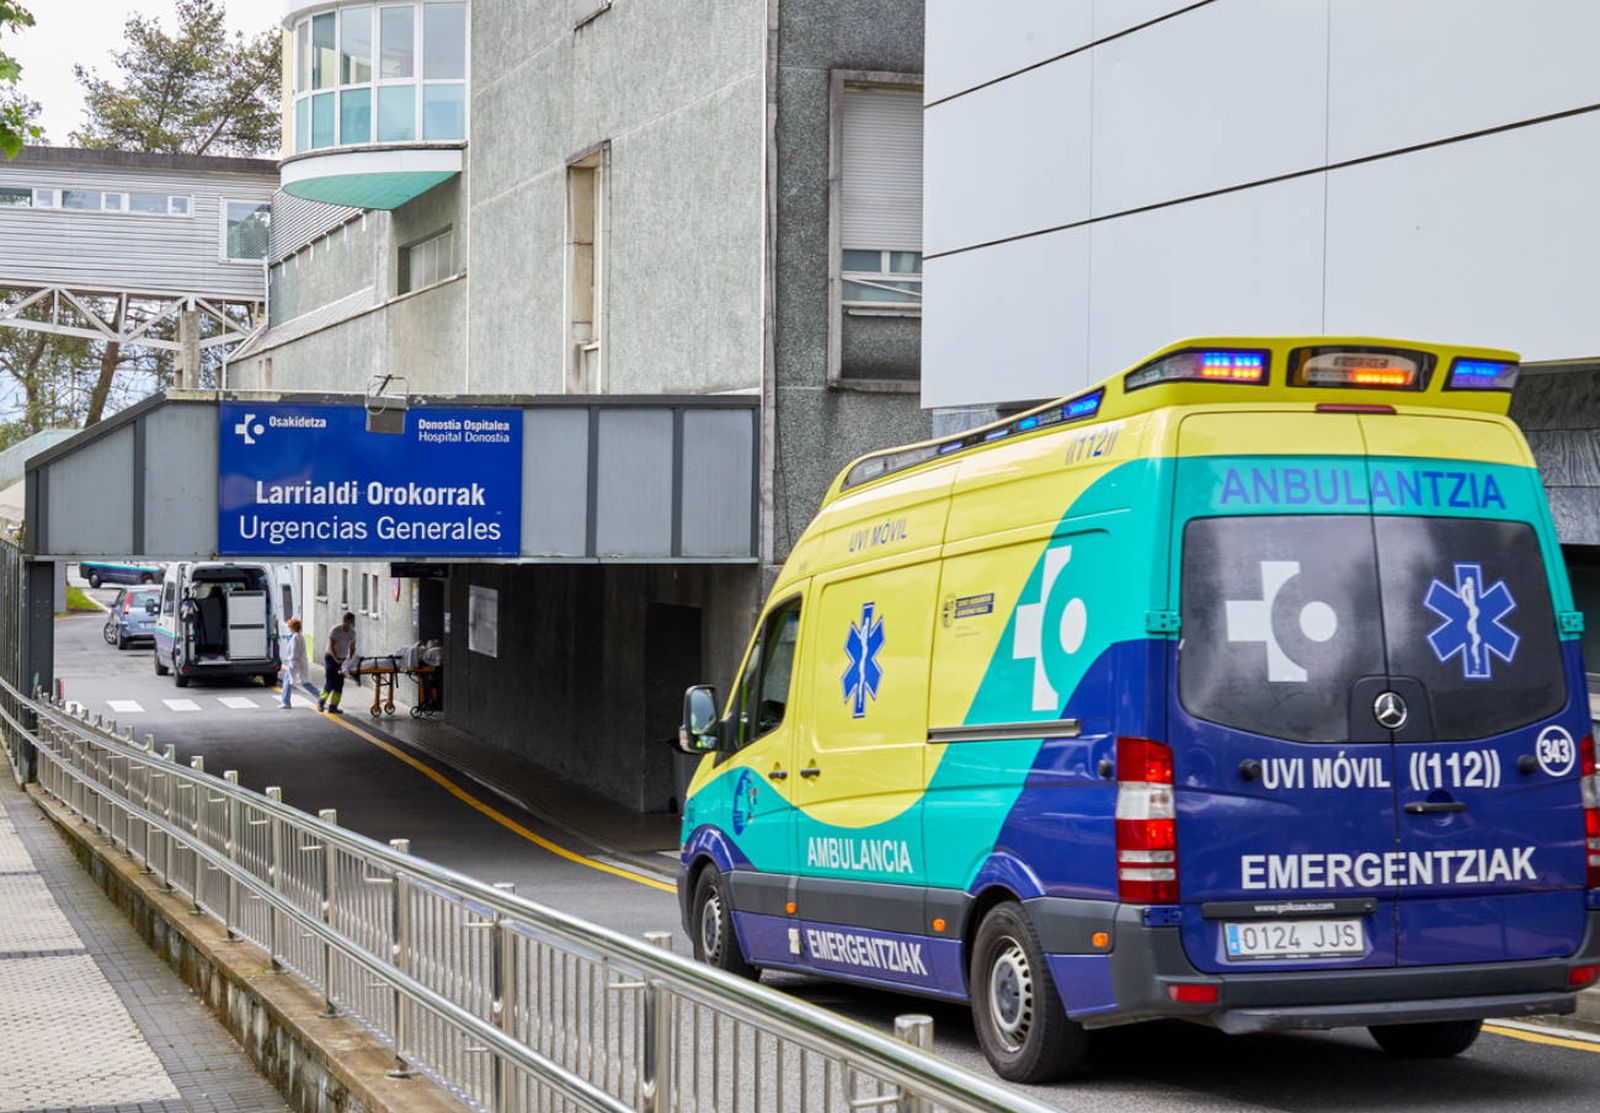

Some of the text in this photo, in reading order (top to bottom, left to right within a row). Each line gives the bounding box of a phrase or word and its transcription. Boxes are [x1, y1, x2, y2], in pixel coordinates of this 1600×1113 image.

[269, 416, 327, 429] Osakidetza
[419, 419, 510, 433] Donostia Ospitalea
[419, 432, 510, 444] Hospital Donostia
[256, 480, 486, 506] Larrialdi Orokorrak
[1220, 467, 1507, 510] ANBULANTZIA
[239, 515, 501, 544] Urgencias Generales
[848, 529, 870, 552] UVI
[1541, 739, 1570, 763] 343
[1261, 759, 1304, 789] UVI
[1313, 751, 1391, 788] MÓVIL
[807, 837, 913, 873] AMBULANCIA
[1241, 847, 1537, 890] EMERGENTZIAK
[1243, 924, 1357, 950] 0124 JJS
[806, 929, 929, 976] EMERGENTZIAK
